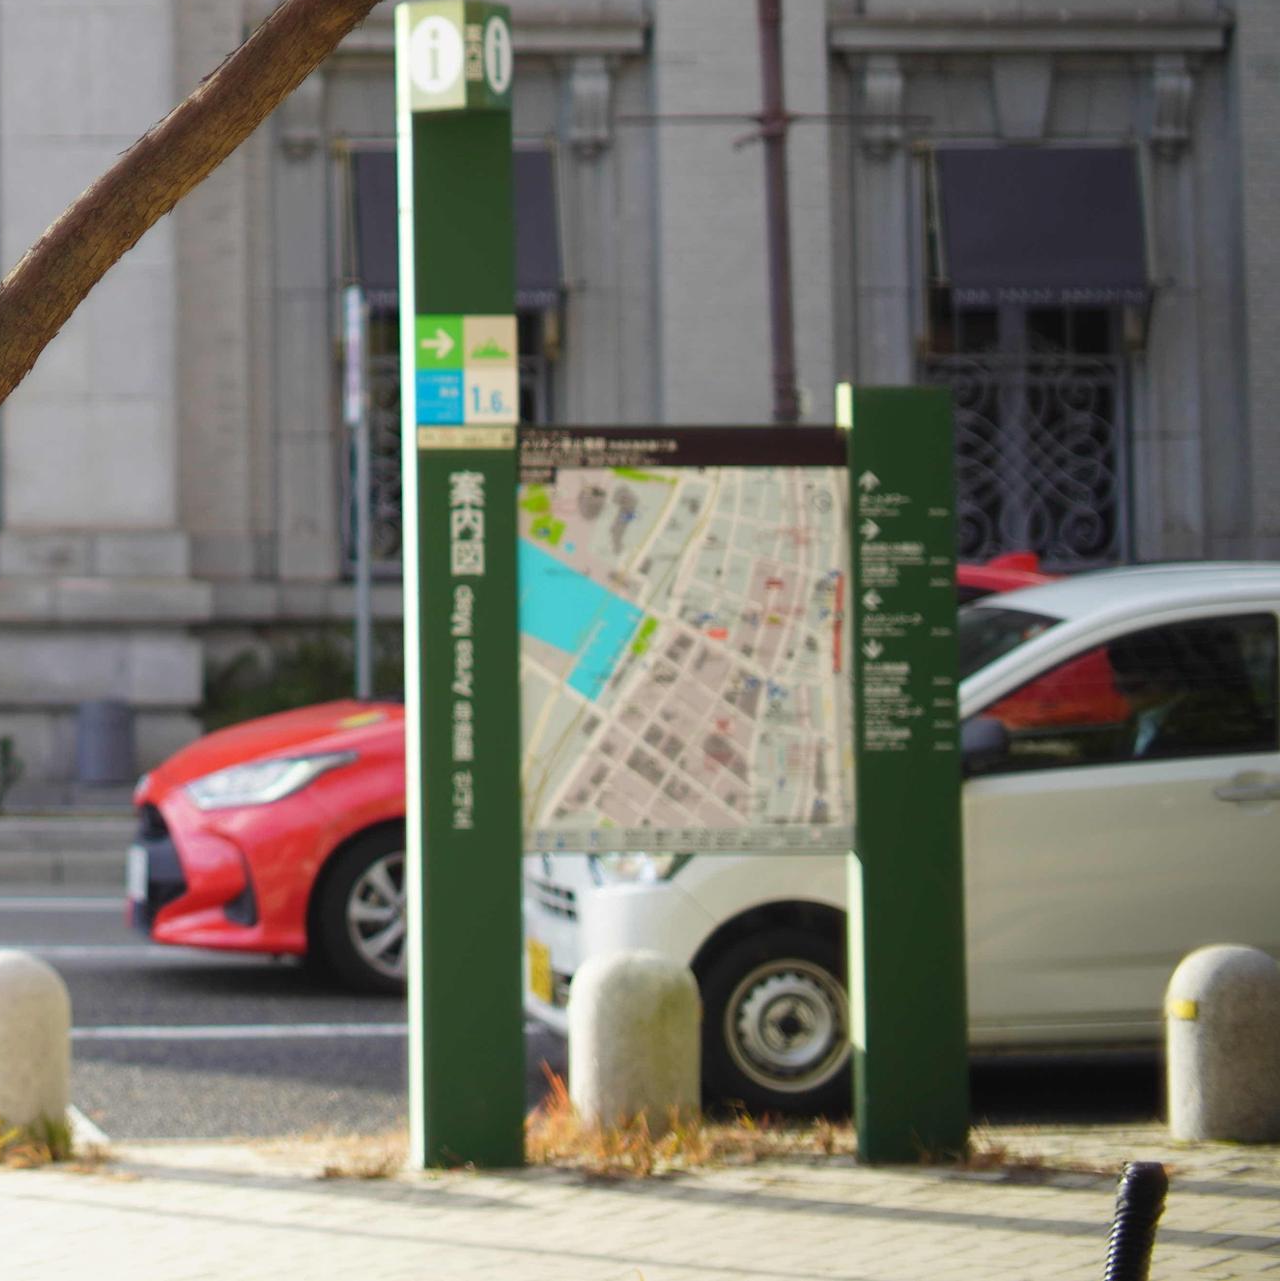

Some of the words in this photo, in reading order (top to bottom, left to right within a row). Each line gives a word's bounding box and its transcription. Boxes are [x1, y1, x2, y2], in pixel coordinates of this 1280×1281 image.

[449, 470, 485, 576] 案内図
[451, 584, 475, 637] Map
[451, 638, 474, 698] Area
